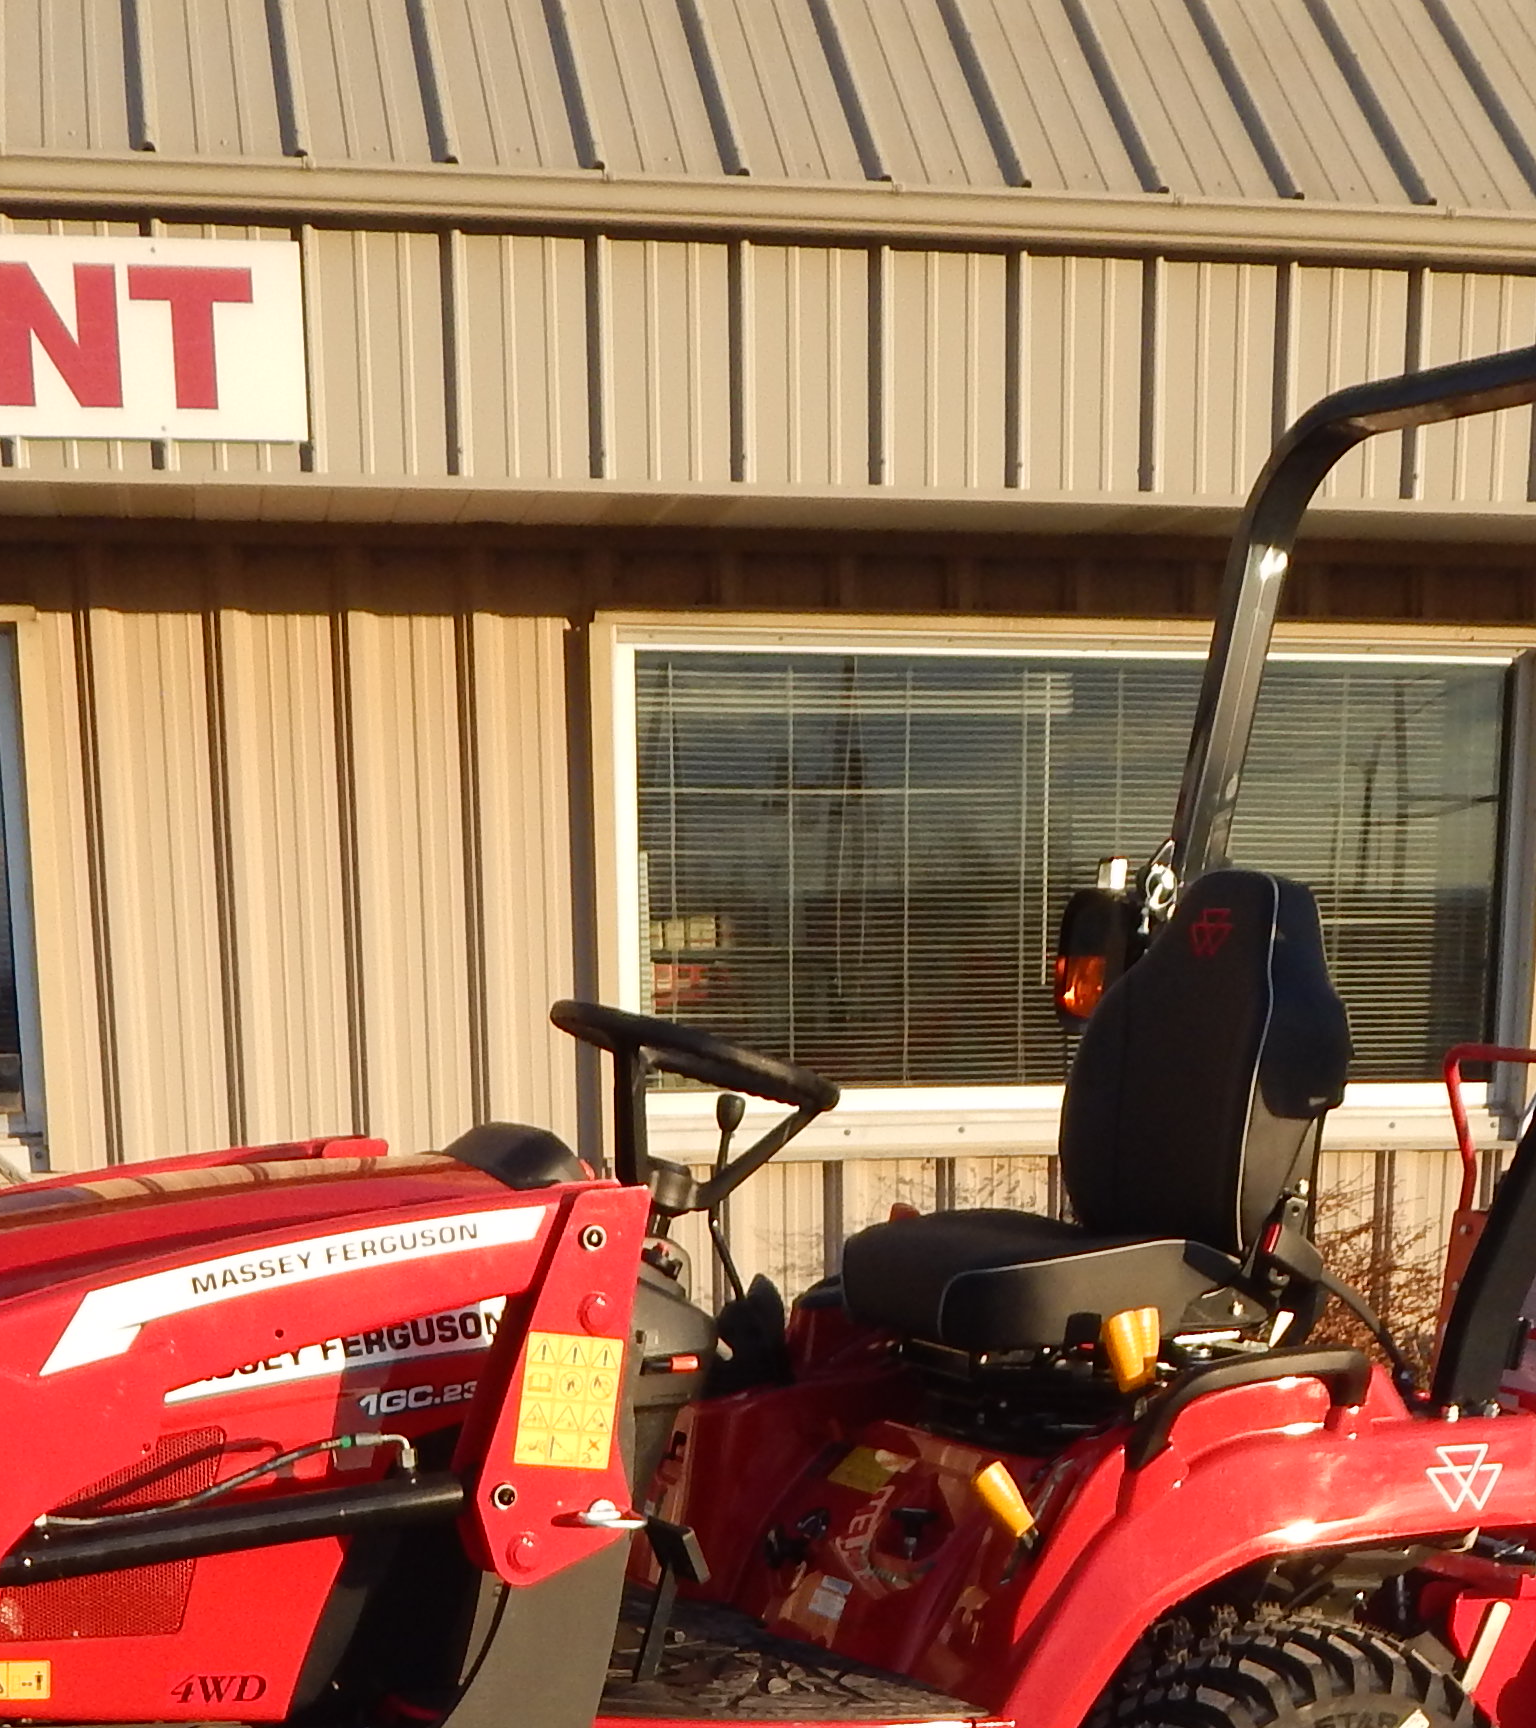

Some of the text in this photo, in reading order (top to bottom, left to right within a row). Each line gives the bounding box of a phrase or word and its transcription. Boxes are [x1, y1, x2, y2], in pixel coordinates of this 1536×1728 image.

[191, 1223, 478, 1294] MASSEY FERGUSON
[170, 1673, 267, 1704] 4WD
